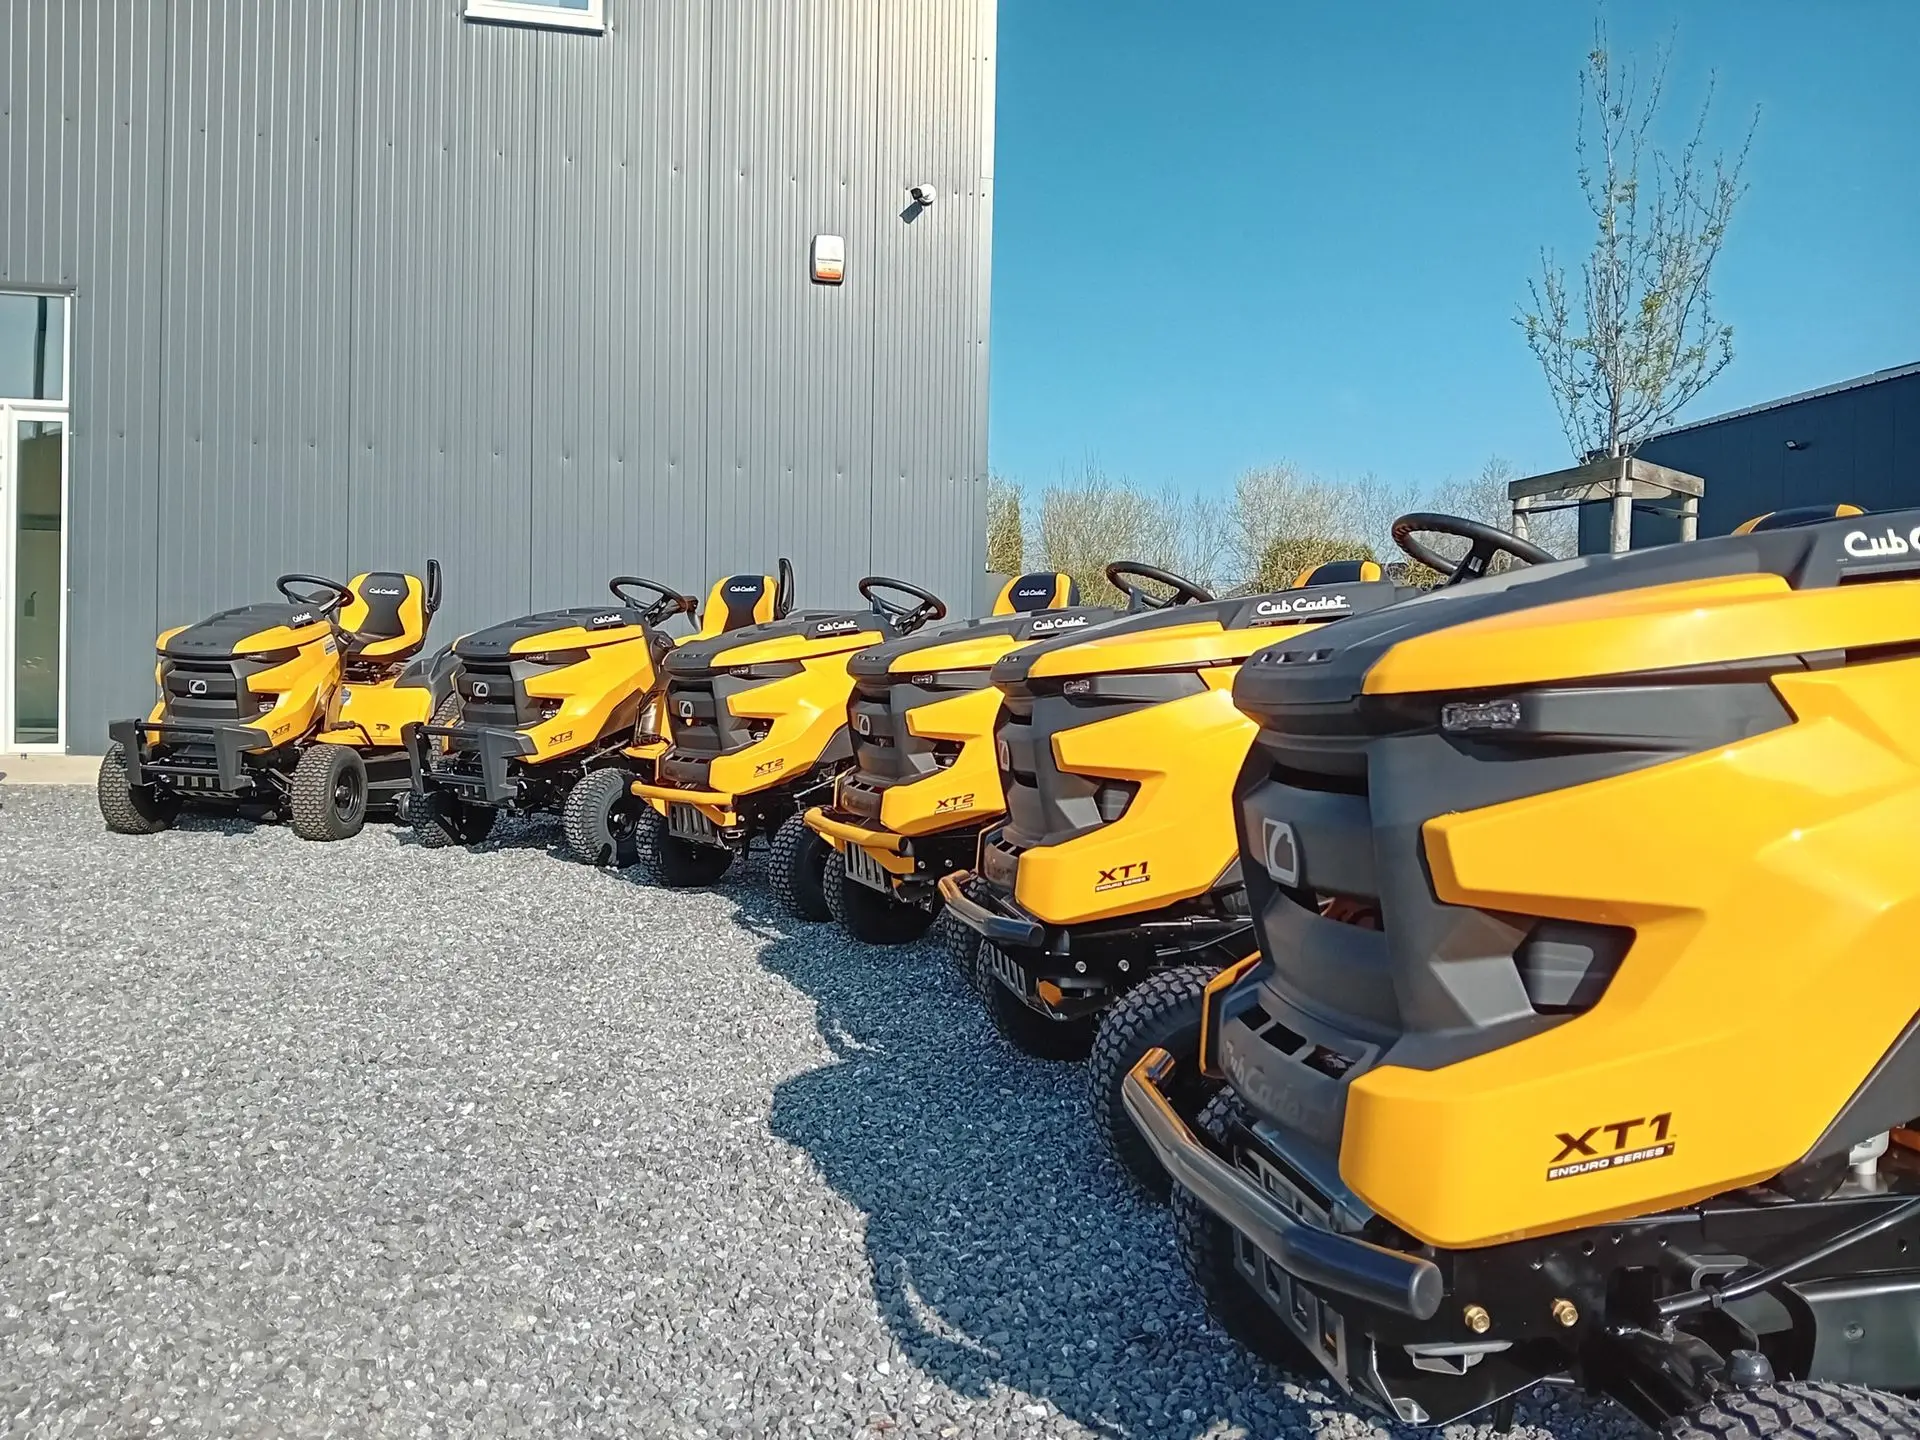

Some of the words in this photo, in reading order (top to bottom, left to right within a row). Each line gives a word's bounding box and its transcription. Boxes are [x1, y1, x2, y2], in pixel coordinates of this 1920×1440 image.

[1844, 528, 1909, 557] Cub
[1256, 600, 1292, 615] Cub
[1292, 594, 1347, 612] Cadet
[817, 622, 833, 631] Cub
[832, 620, 857, 630] Cadet
[1033, 619, 1055, 631] Cub
[1054, 615, 1089, 629] Cadet
[755, 758, 784, 773] XT2
[936, 793, 975, 809] XT2
[1096, 860, 1149, 884] XT1
[1549, 1111, 1673, 1164] XT1
[1549, 1158, 1611, 1179] ENDURO
[1613, 1146, 1665, 1165] SERIES
